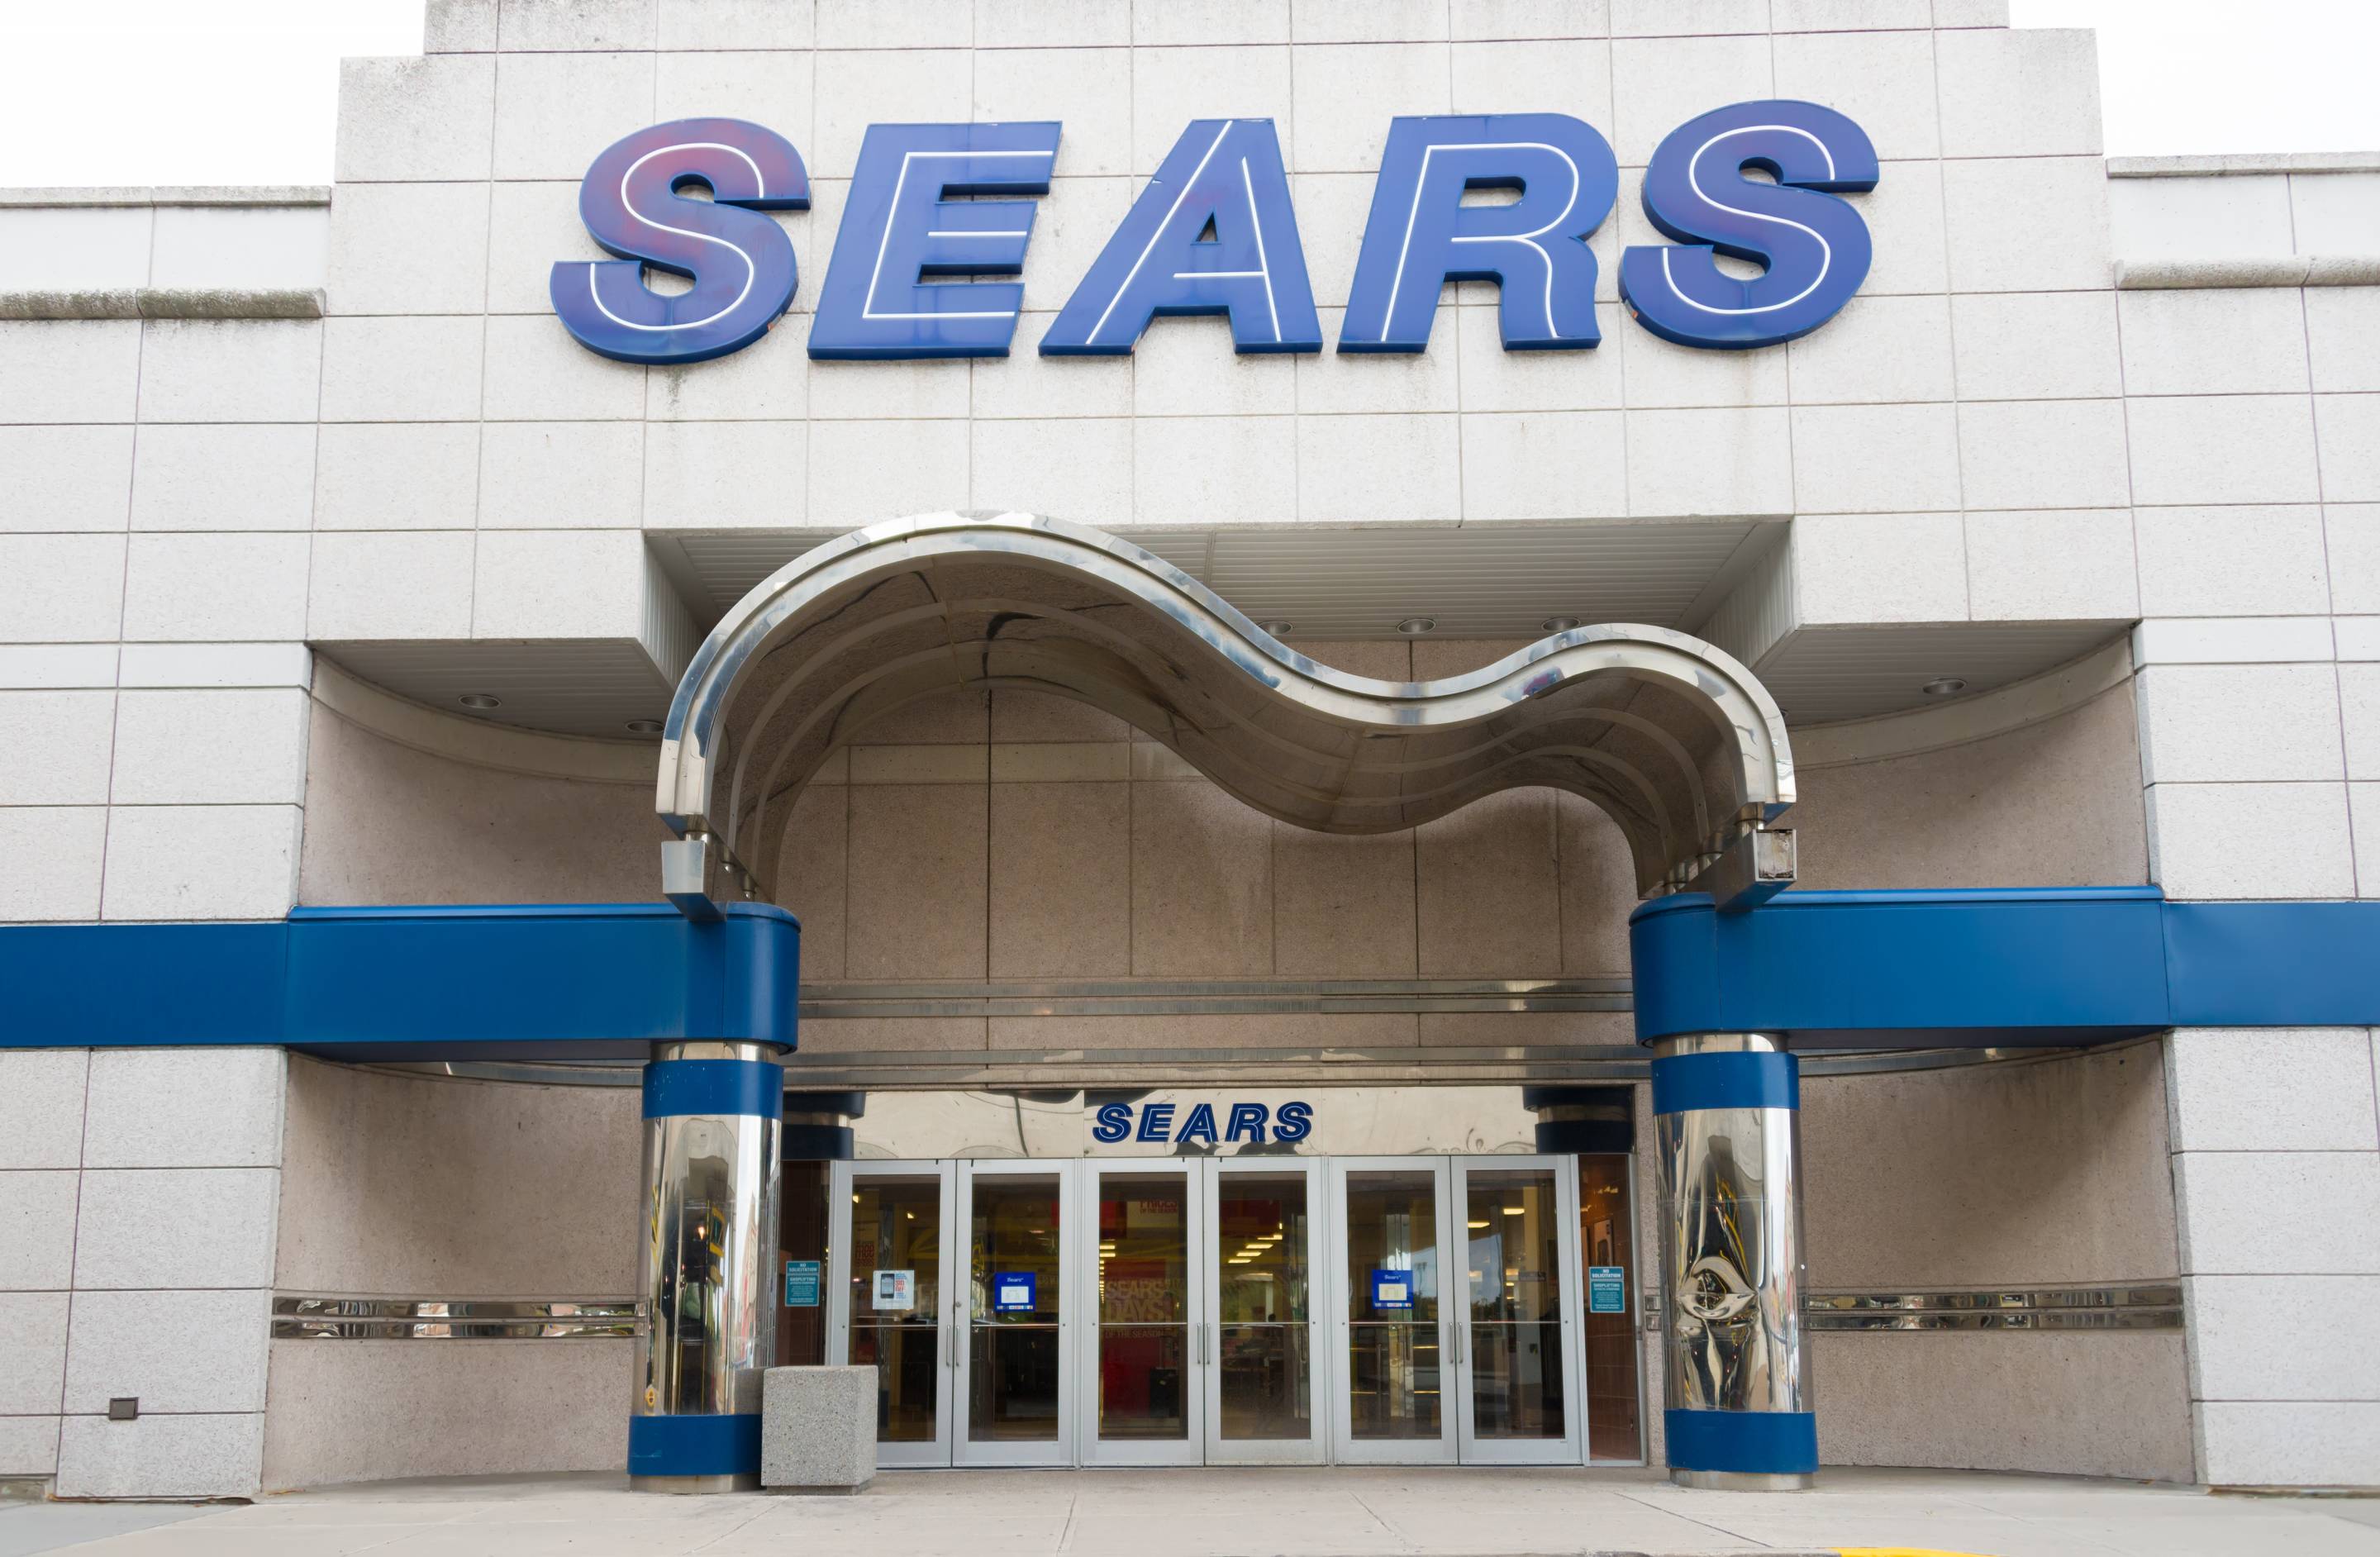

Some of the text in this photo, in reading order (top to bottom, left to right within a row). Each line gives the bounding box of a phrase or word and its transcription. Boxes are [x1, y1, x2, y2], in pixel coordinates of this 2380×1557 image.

[550, 99, 1880, 365] SEARS
[1092, 1101, 1314, 1144] SEARS
[1105, 1278, 1164, 1298] SEARS
[1105, 1298, 1164, 1323] DAYS
